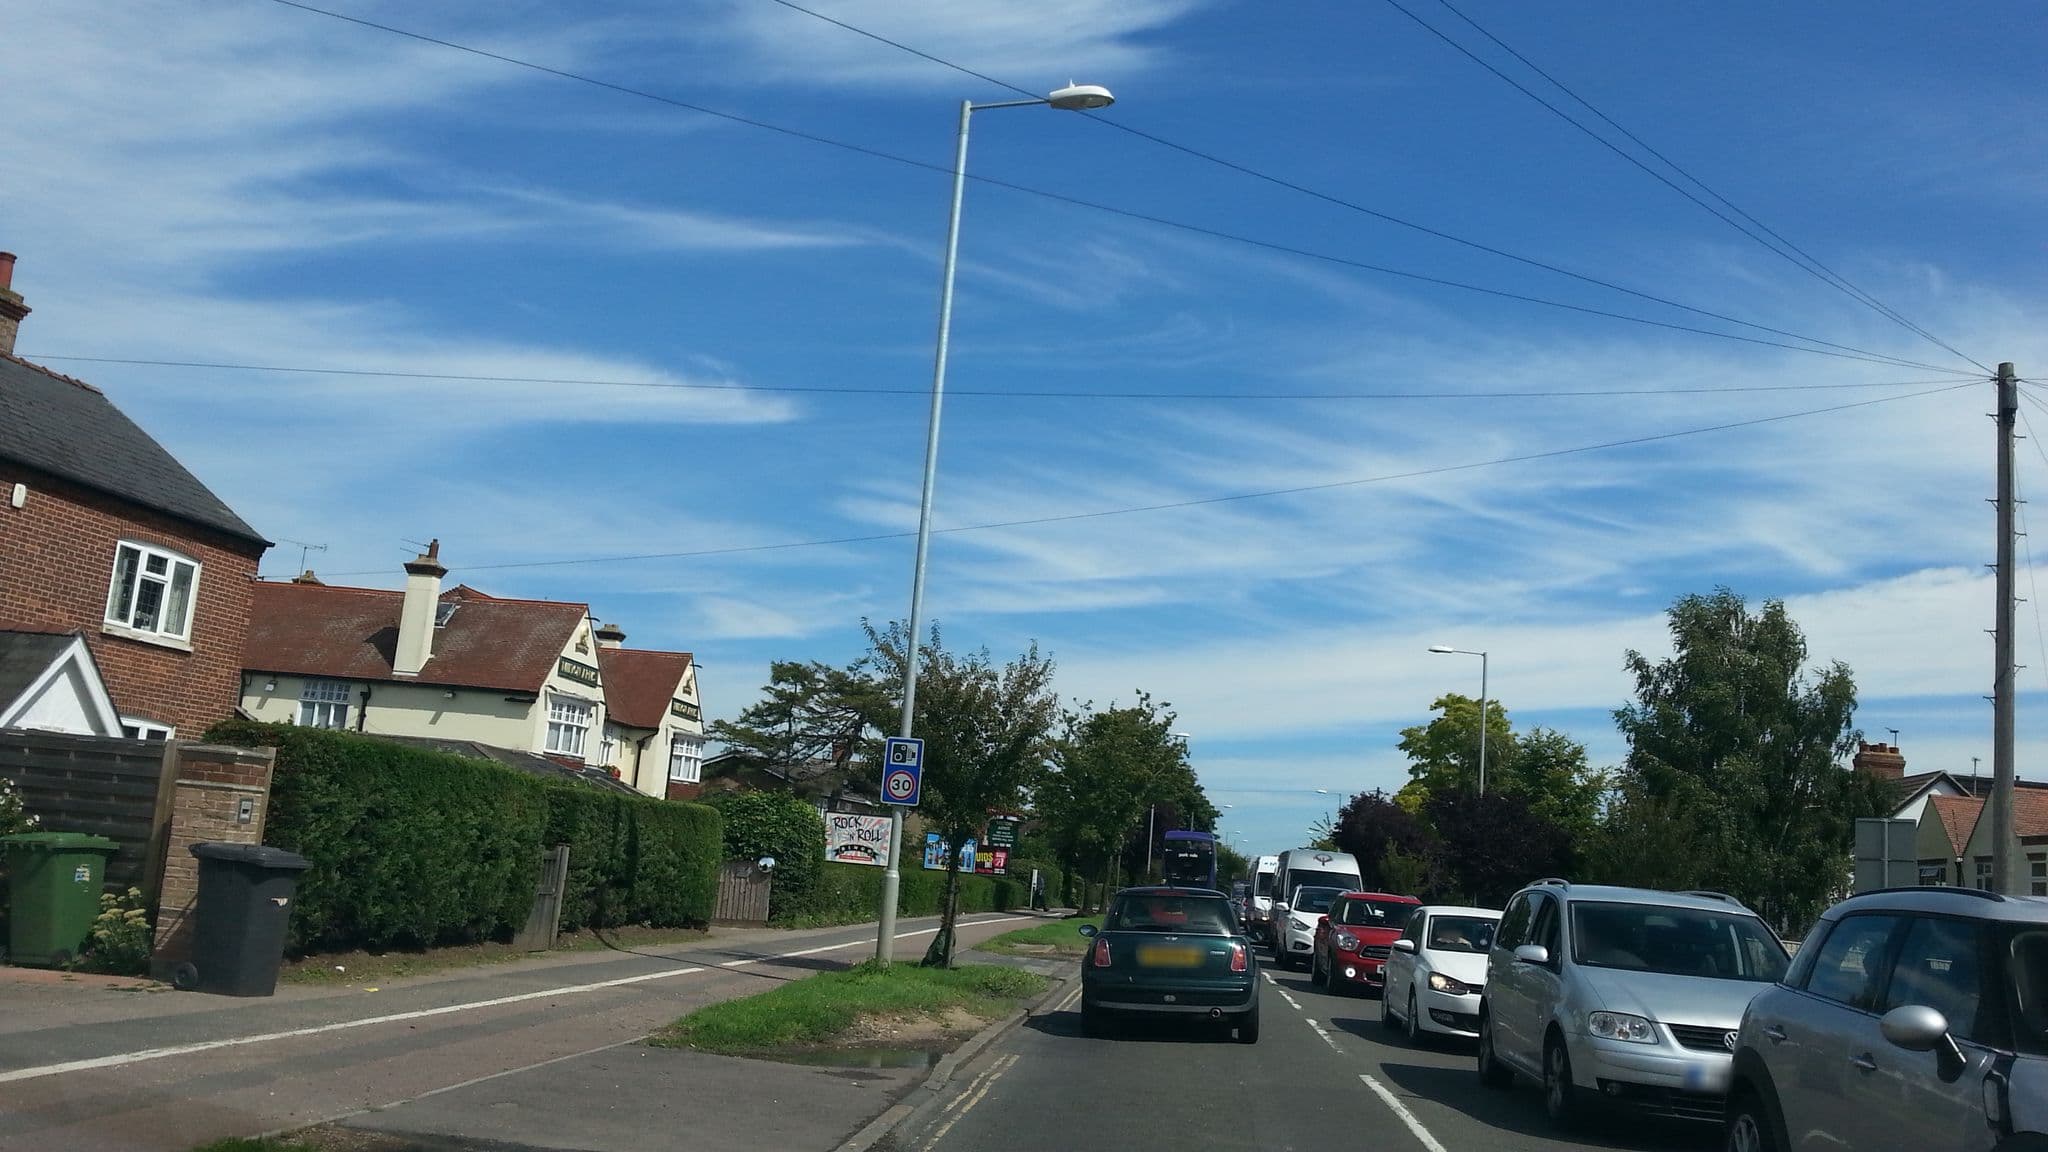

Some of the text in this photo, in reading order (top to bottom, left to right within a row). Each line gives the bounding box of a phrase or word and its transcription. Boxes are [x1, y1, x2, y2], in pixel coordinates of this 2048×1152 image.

[892, 779, 911, 791] 30
[832, 816, 861, 830] ROCK
[856, 829, 882, 841] ROLL
